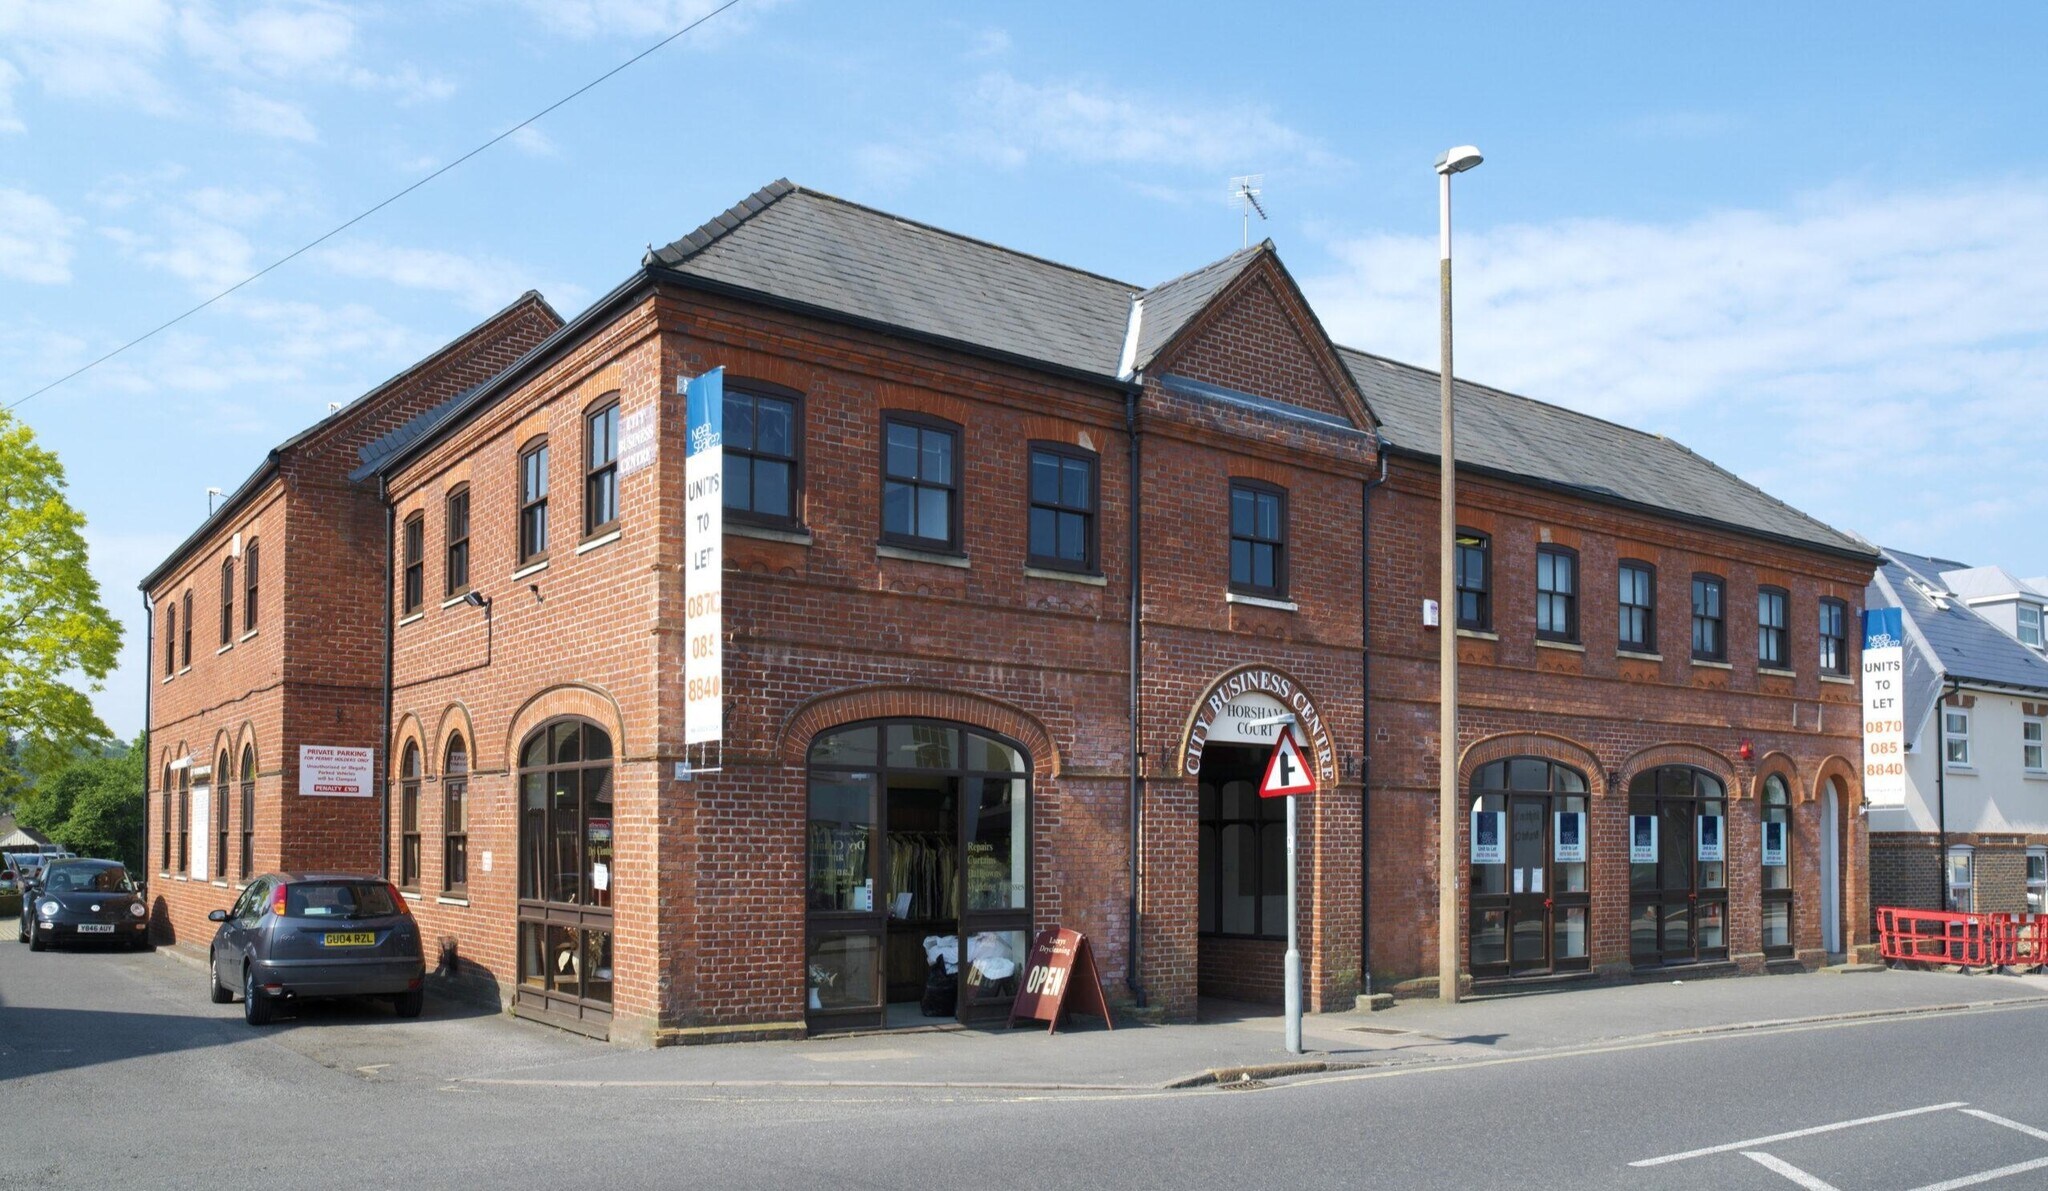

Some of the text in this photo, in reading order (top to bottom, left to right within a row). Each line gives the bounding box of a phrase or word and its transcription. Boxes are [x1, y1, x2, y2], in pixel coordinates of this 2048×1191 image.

[618, 425, 654, 454] BUSINESS
[688, 473, 720, 501] UNITS
[697, 513, 710, 534] TO
[694, 548, 714, 571] LET
[1864, 660, 1900, 673] UNITS
[688, 675, 720, 702] 8840
[1875, 680, 1890, 690] TO
[1872, 698, 1894, 709] LET
[1227, 704, 1283, 719] HORSHAM
[1186, 671, 1334, 781] CITY BUSINESS CENTRE
[1237, 722, 1274, 736] COURT
[1866, 720, 1902, 734] 0870
[1870, 742, 1898, 754] 085
[1866, 763, 1902, 776] 8840
[968, 842, 994, 853] Repairs
[967, 855, 996, 865] Curtains
[326, 934, 374, 944] GU04 RZL
[1039, 945, 1071, 956] Drycleaning
[1026, 965, 1066, 996] OPEN
